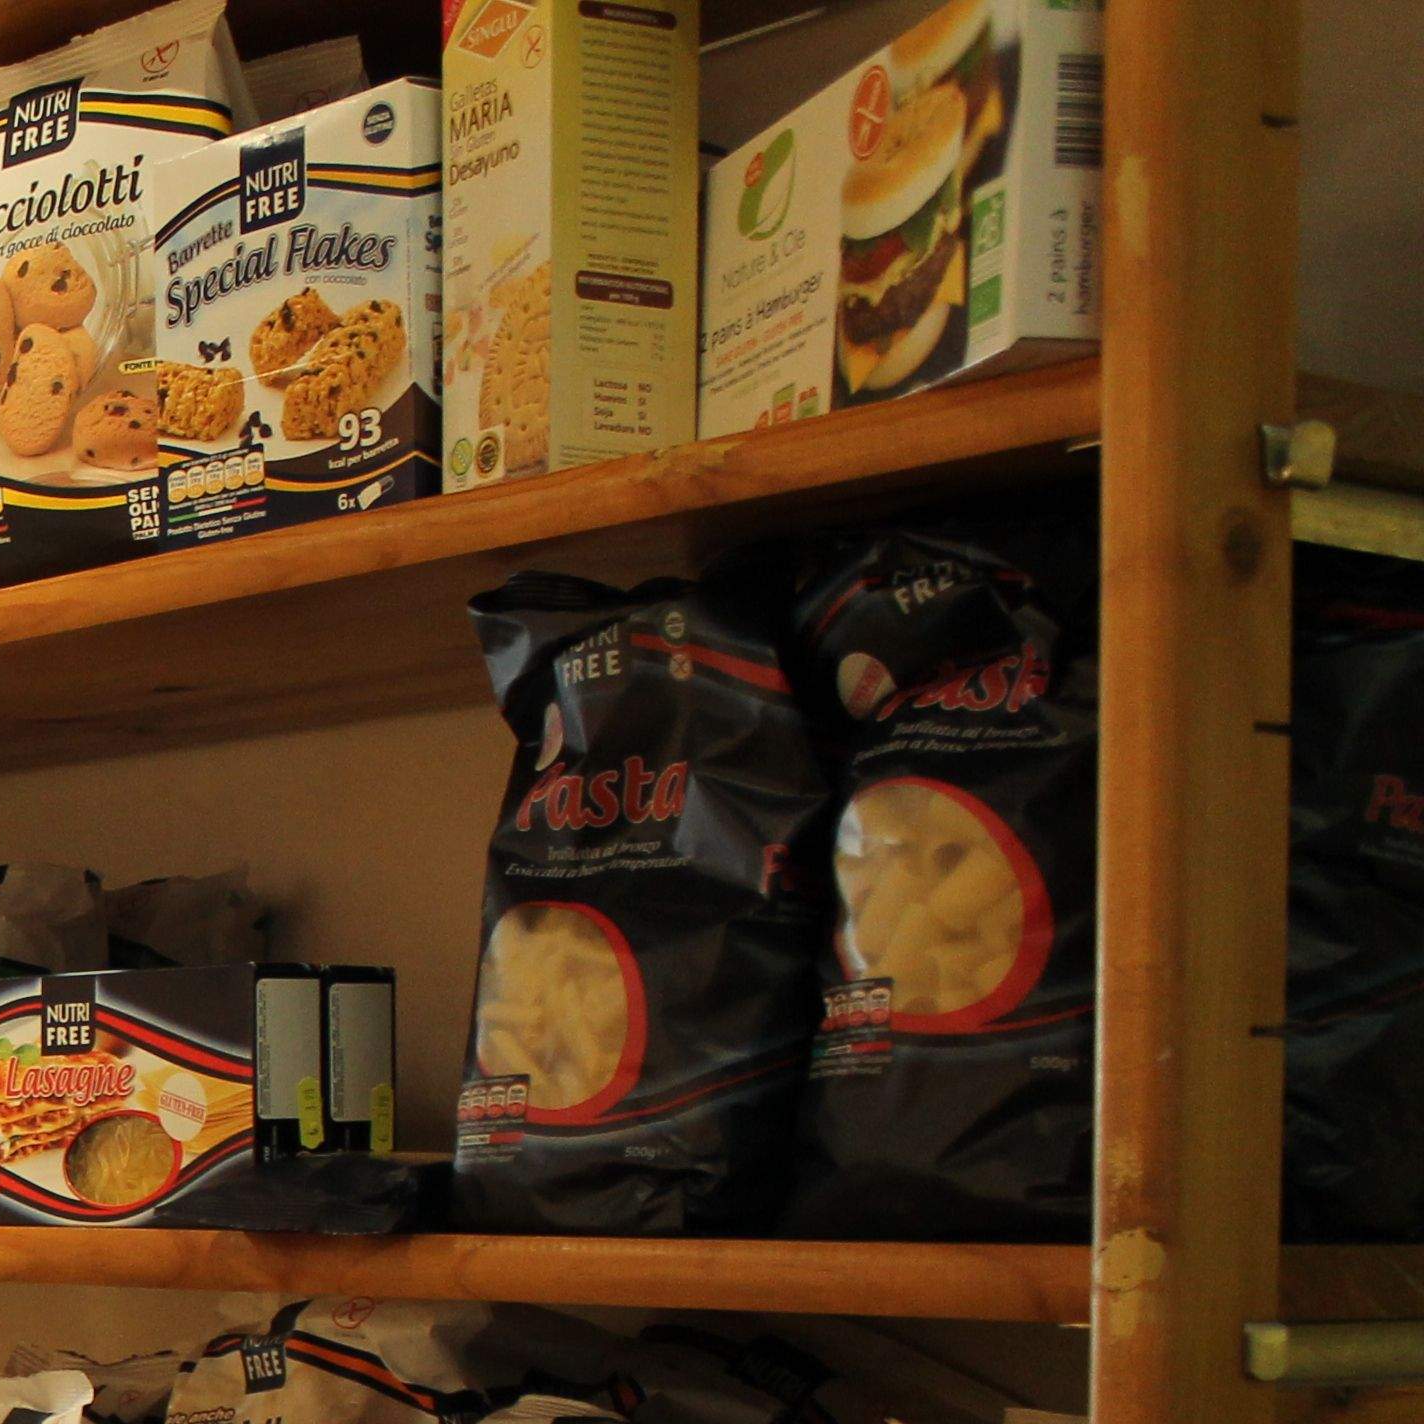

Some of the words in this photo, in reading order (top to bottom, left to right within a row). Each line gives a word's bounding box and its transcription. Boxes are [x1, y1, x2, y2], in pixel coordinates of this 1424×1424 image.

[13, 86, 73, 128] NUTRI
[9, 115, 71, 157] FREE
[245, 158, 299, 197] NUTRI
[448, 142, 521, 187] Desayuno
[245, 186, 300, 223] FREE
[6, 234, 43, 263] gocce
[45, 226, 60, 244] di
[61, 213, 136, 241] cioccolato
[166, 219, 234, 276] Barrette
[165, 233, 279, 329] Special
[283, 222, 398, 273] Flakes
[124, 359, 153, 371] FONTE
[337, 407, 382, 451] 93
[328, 457, 347, 471] kcal
[347, 453, 363, 468] per
[363, 437, 400, 460] barretta
[337, 492, 356, 511] 6x
[562, 652, 623, 688] FREE
[46, 1002, 90, 1024] NUTRI
[46, 1025, 91, 1047] FREE
[5, 1056, 135, 1106] Lasagne
[160, 1094, 206, 1122] GLUTEN-FREE
[246, 1350, 283, 1381] FREE
